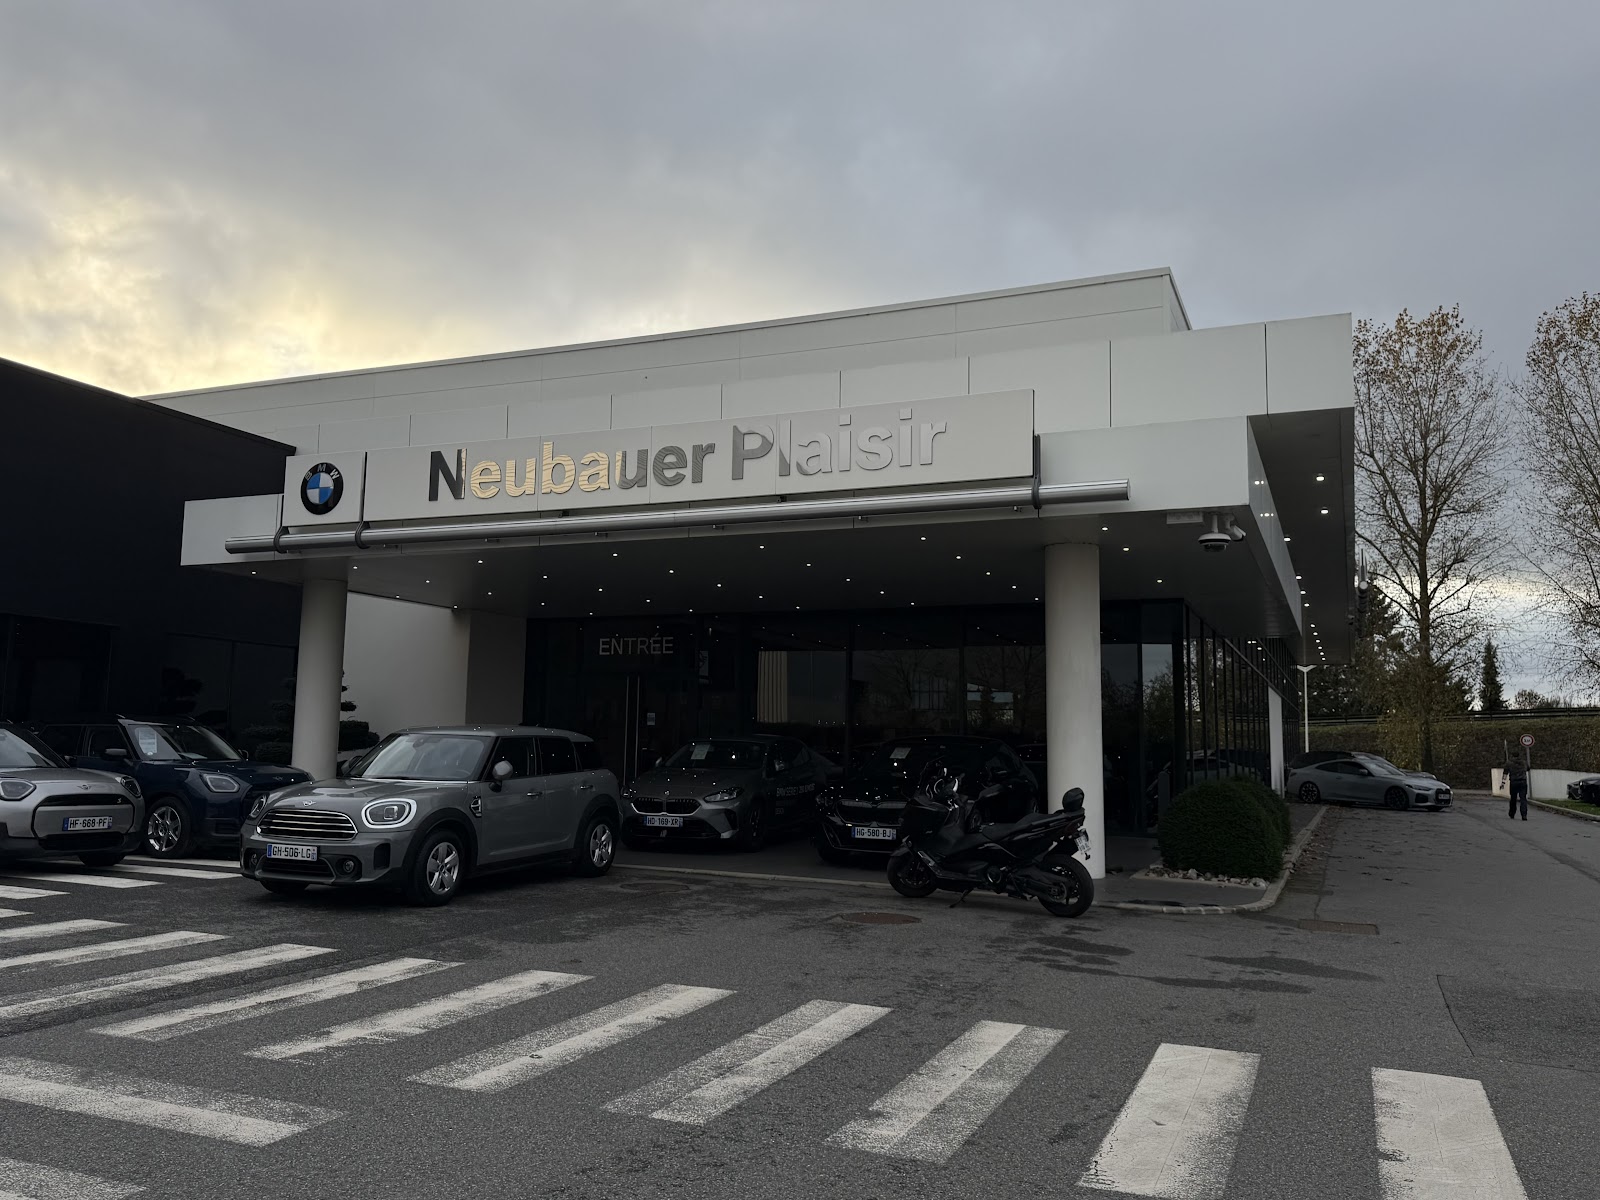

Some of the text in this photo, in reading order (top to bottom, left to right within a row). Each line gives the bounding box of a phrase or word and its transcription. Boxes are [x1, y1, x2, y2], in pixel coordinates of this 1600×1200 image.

[428, 408, 949, 502] Neubauer Plaisir
[304, 463, 340, 481] BMW
[599, 632, 674, 656] ENTRÉE
[69, 818, 107, 829] HF-668-PF
[856, 828, 891, 838] HG-580-BJ
[272, 845, 311, 859] GH-506-LG
